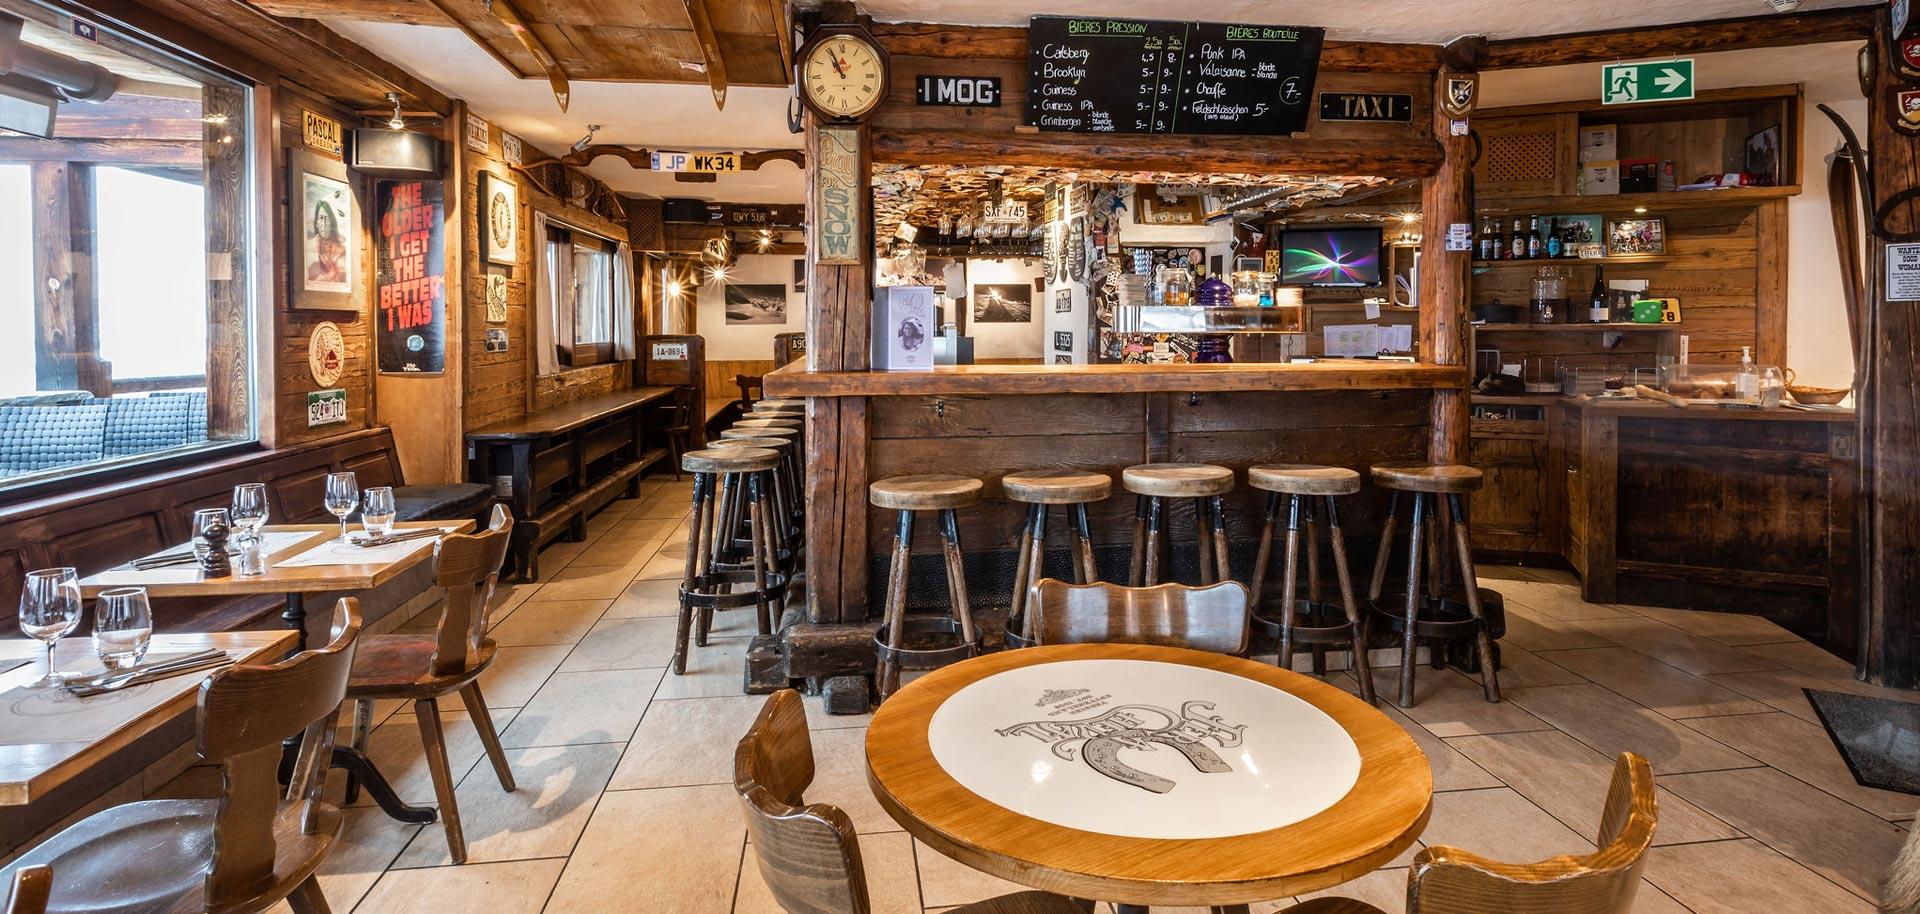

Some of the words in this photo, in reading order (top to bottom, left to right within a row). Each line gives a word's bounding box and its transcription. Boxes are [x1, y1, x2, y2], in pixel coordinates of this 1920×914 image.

[1106, 20, 1148, 33] PRESSION
[1200, 43, 1224, 60] Punk
[1231, 48, 1246, 60] IPA
[1043, 62, 1086, 84] Brooklyn
[1199, 60, 1247, 77] Valaisanne
[937, 78, 994, 104] MOG
[1080, 99, 1094, 110] IPA
[1340, 96, 1394, 118] TAXI
[307, 114, 337, 144] PASCAL
[666, 155, 686, 170] JP
[694, 156, 735, 171] WK34
[821, 176, 840, 189] FOR
[392, 182, 422, 209] THE
[382, 203, 433, 237] OLDER
[823, 187, 852, 255] SNOW
[1008, 205, 1025, 218] 745
[389, 235, 396, 260] I
[400, 229, 430, 257] GET
[393, 254, 424, 282] THE
[380, 275, 440, 309] BETTER
[388, 308, 394, 332] I
[398, 299, 433, 329] WAS
